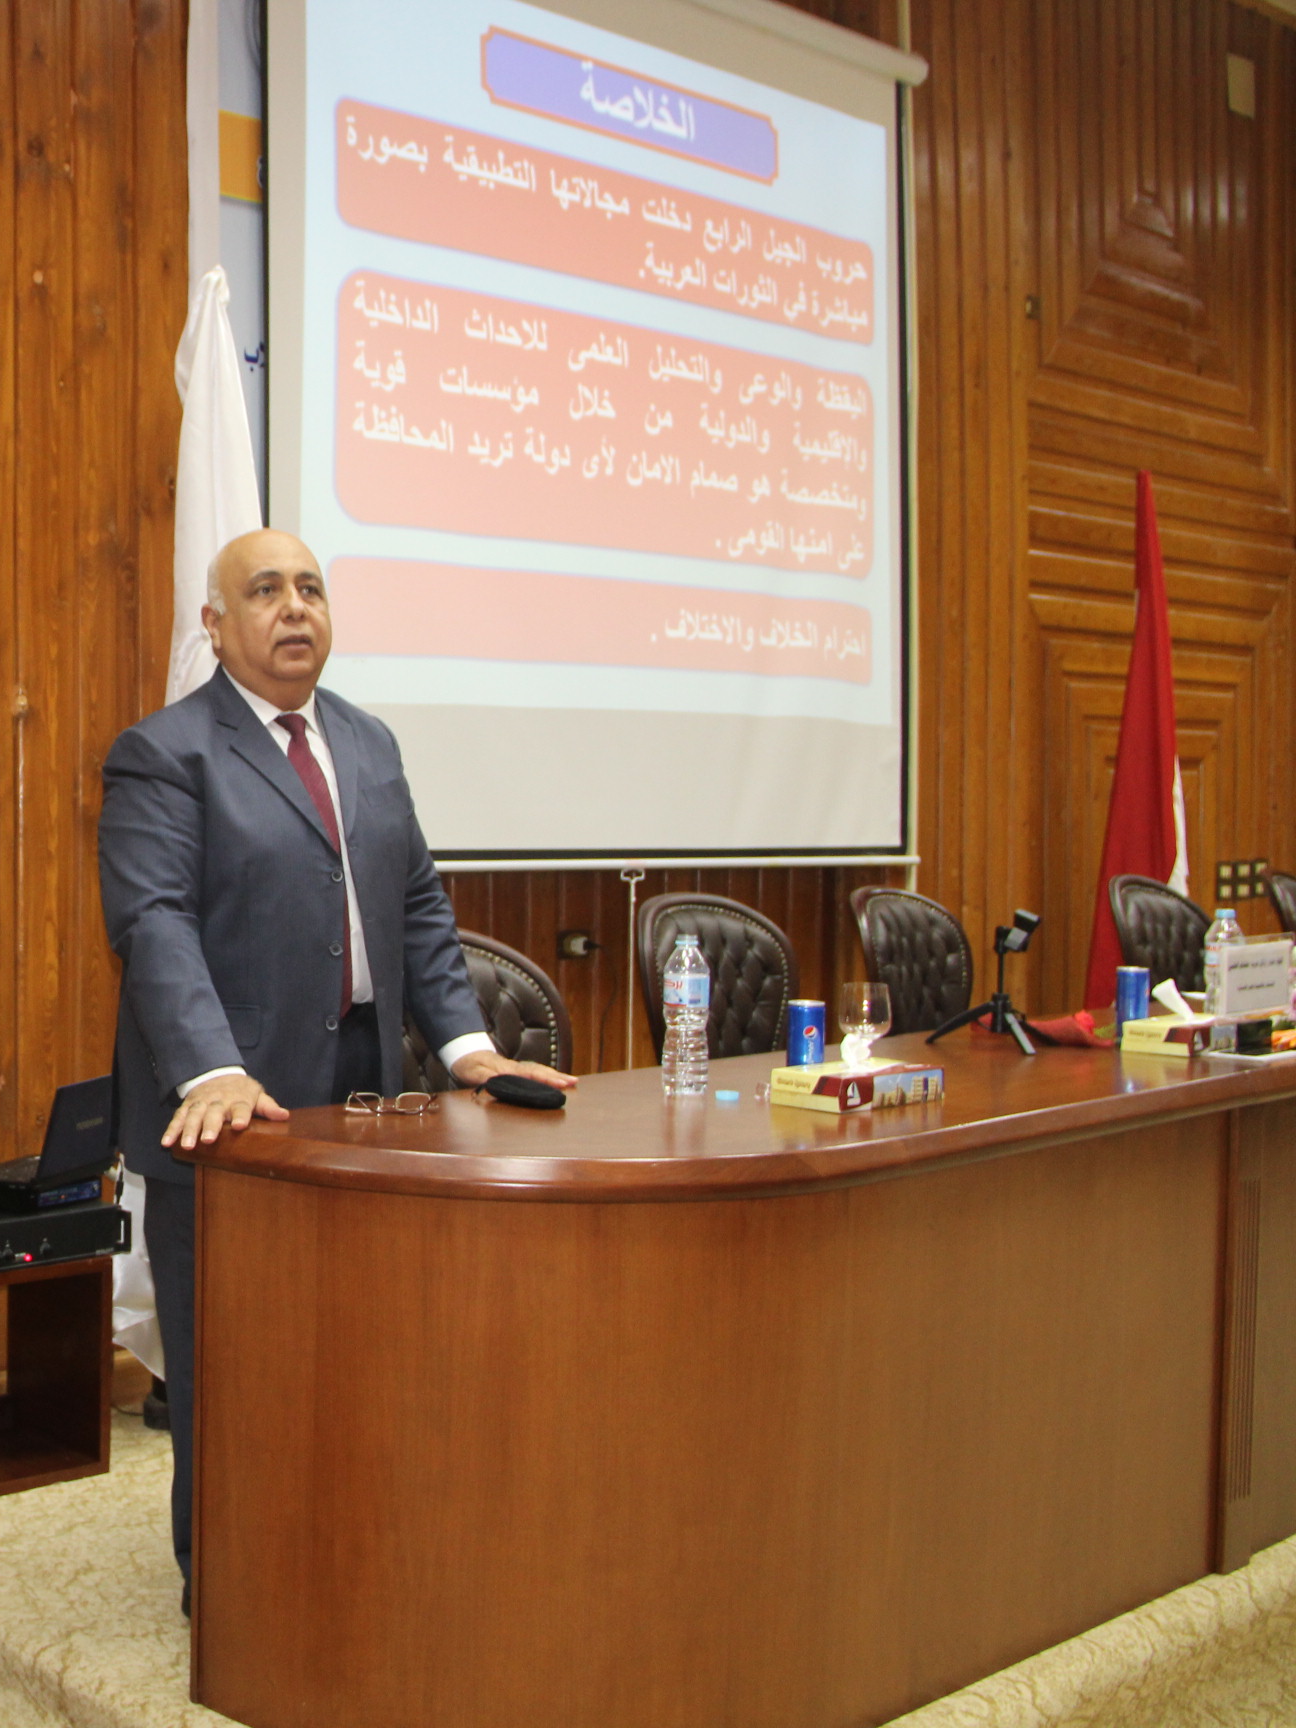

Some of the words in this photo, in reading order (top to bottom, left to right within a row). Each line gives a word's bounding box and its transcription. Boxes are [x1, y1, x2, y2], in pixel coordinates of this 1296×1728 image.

[580, 61, 695, 142] الخلاصة
[346, 116, 428, 173] بصورة
[443, 135, 536, 192] التطبيقية
[550, 169, 630, 219] مجالاتها
[641, 197, 692, 232] دخلت
[703, 216, 752, 253] الرابع
[762, 228, 806, 267] الجيل
[713, 268, 777, 308] الثورات
[816, 252, 867, 283] حروب
[354, 280, 438, 334] الداخلية
[812, 290, 868, 331] مباشرة
[464, 308, 547, 351] للاحداث
[353, 340, 406, 392] قوية
[648, 344, 722, 394] والتحليل
[439, 365, 539, 413] مؤسسات
[569, 383, 616, 420] خلال
[816, 377, 867, 420] اليقظة
[353, 402, 453, 454] المحافظة
[644, 402, 673, 435] من
[699, 402, 770, 454] والدولية
[467, 432, 513, 467] تريد
[524, 427, 570, 474] دولة
[626, 450, 681, 486] الامان
[690, 460, 738, 498] صمام
[747, 473, 771, 503] هو
[780, 467, 867, 521] ومتخصصة
[789, 527, 832, 563] امنها
[664, 608, 754, 653] والاختلاف
[760, 618, 818, 649] الخلاف
[823, 626, 866, 660] احترام
